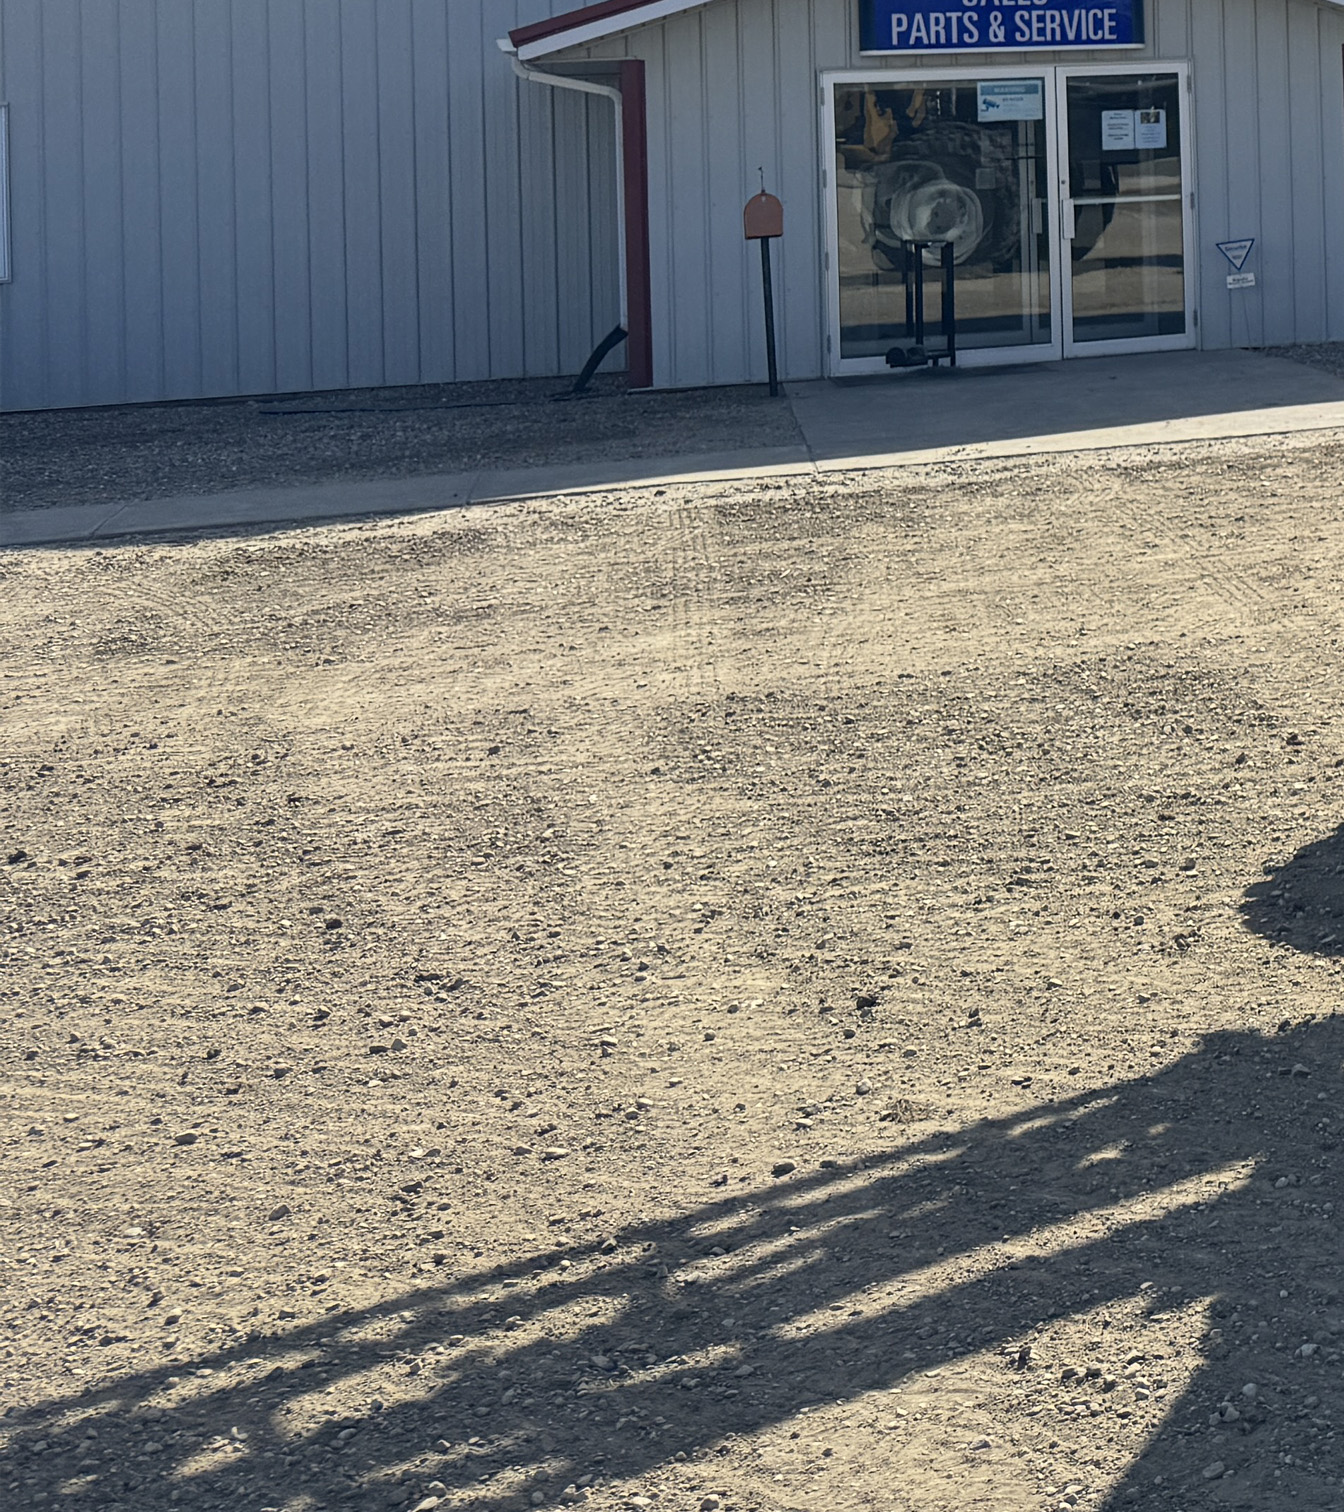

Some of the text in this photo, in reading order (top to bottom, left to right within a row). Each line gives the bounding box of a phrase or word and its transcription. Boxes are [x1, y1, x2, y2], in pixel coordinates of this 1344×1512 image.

[891, 8, 1118, 45] PARTS & SERVICE
